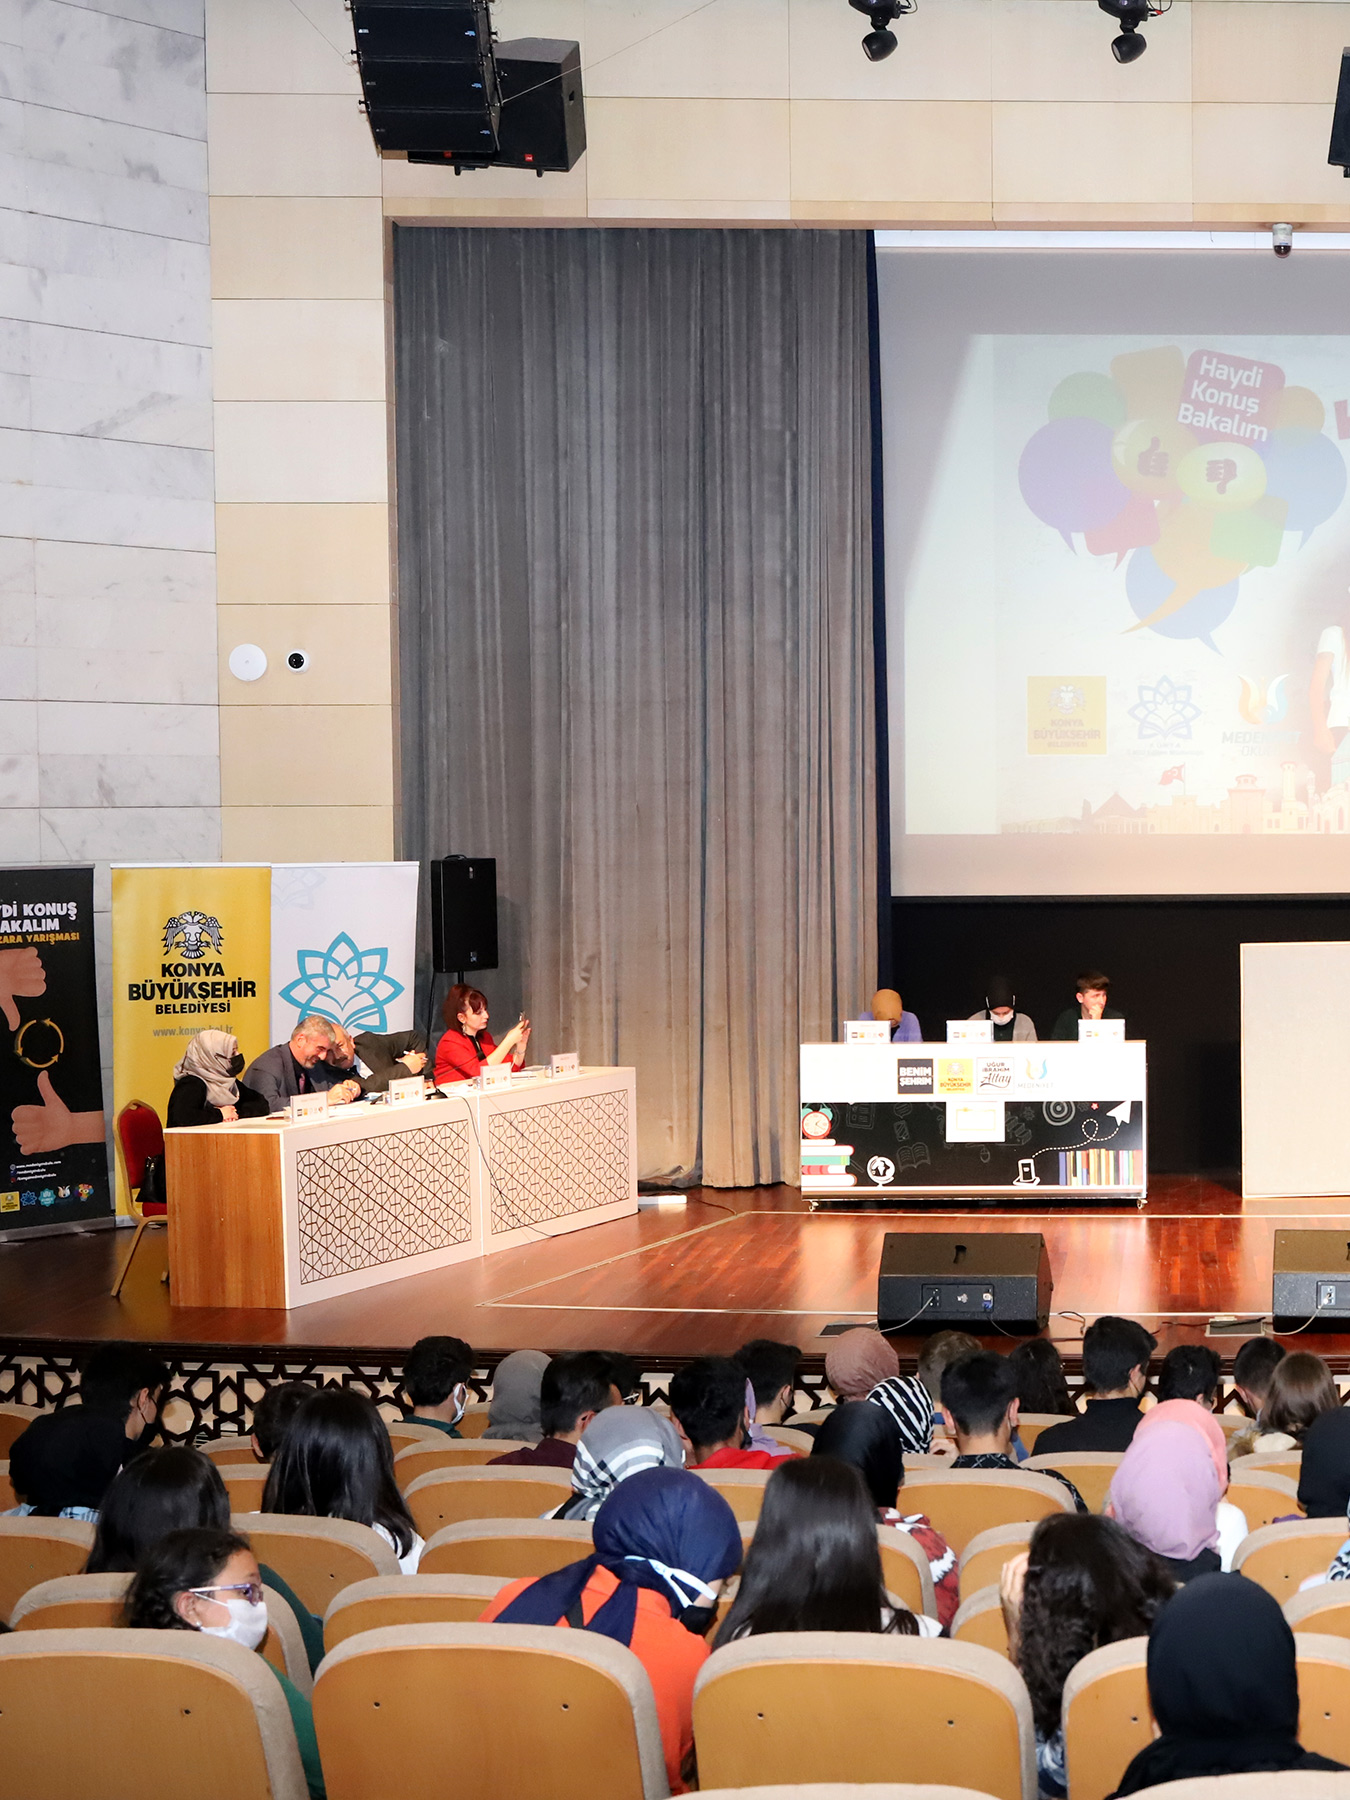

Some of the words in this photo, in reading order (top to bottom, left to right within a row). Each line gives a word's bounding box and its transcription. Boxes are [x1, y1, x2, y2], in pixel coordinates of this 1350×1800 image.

[1199, 355, 1264, 390] Haydi
[1190, 379, 1260, 417] Konuş
[1177, 402, 1269, 442] Bakalım
[1050, 718, 1084, 727] KONYA
[0, 901, 18, 918] Dİ
[23, 902, 78, 920] KONUŞ
[26, 932, 80, 945] YARIŞMASI
[161, 963, 225, 977] KONYA
[128, 977, 257, 1001] BÜYÜKŞEHİR
[155, 1000, 231, 1014] BELEDİYESİ
[152, 1024, 234, 1037] www.konyltr
[899, 1066, 932, 1076] BENİM
